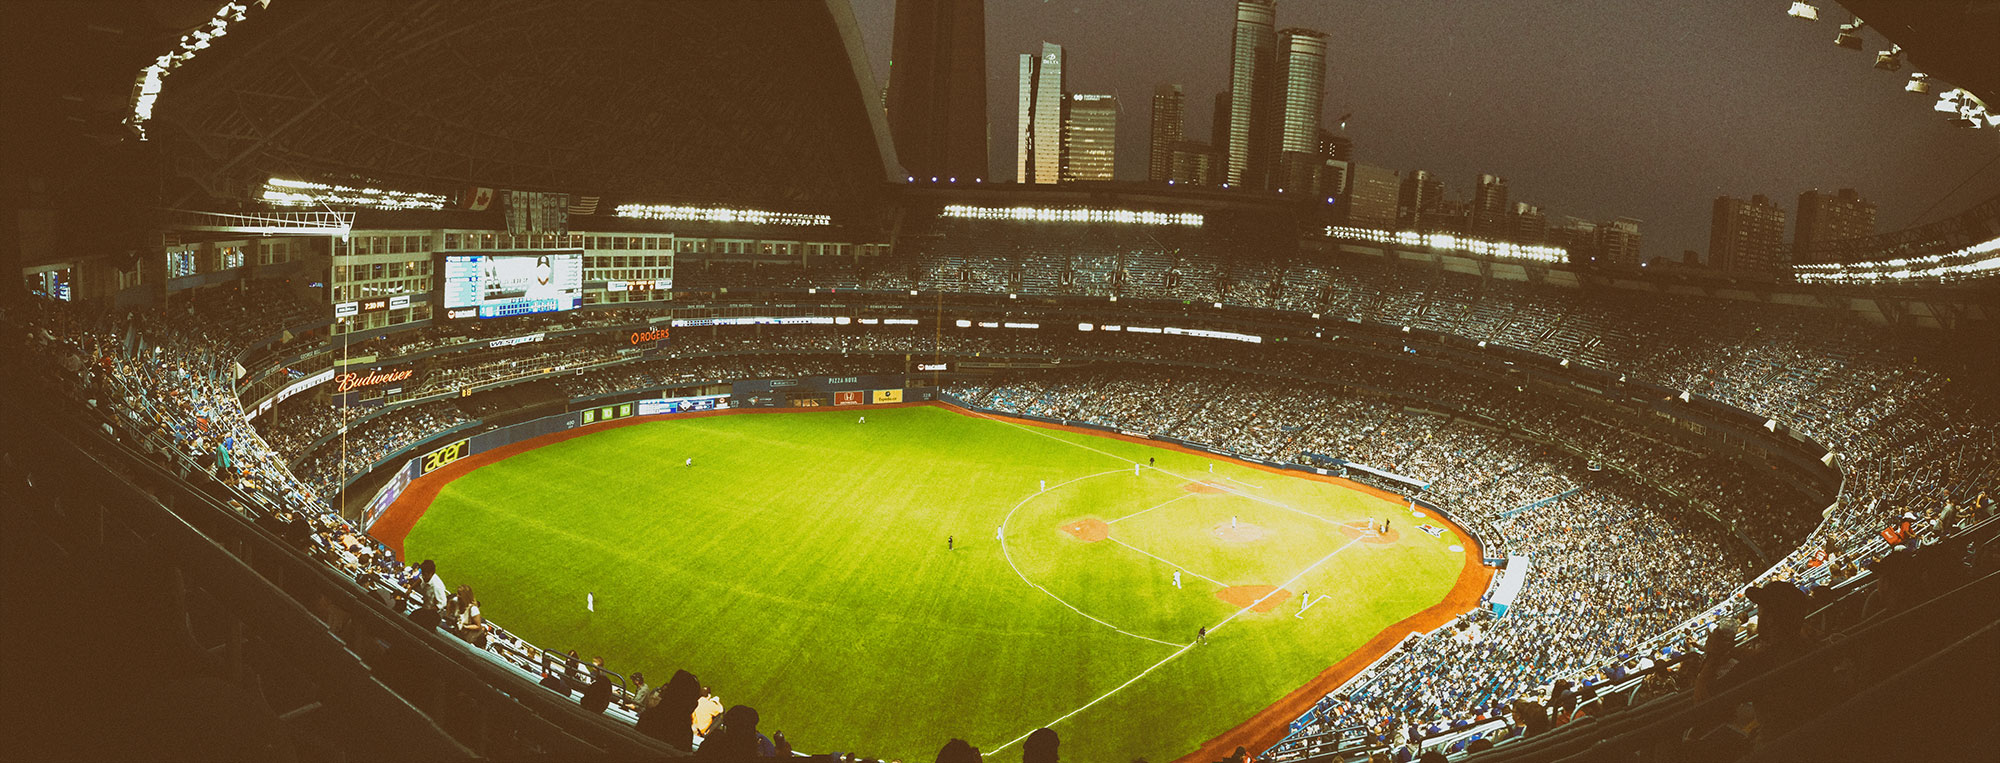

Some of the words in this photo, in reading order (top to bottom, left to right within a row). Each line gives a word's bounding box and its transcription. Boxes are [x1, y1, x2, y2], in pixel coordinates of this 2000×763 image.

[640, 328, 670, 342] ROGERS
[335, 369, 413, 392] Budweiser
[424, 441, 466, 473] acer
